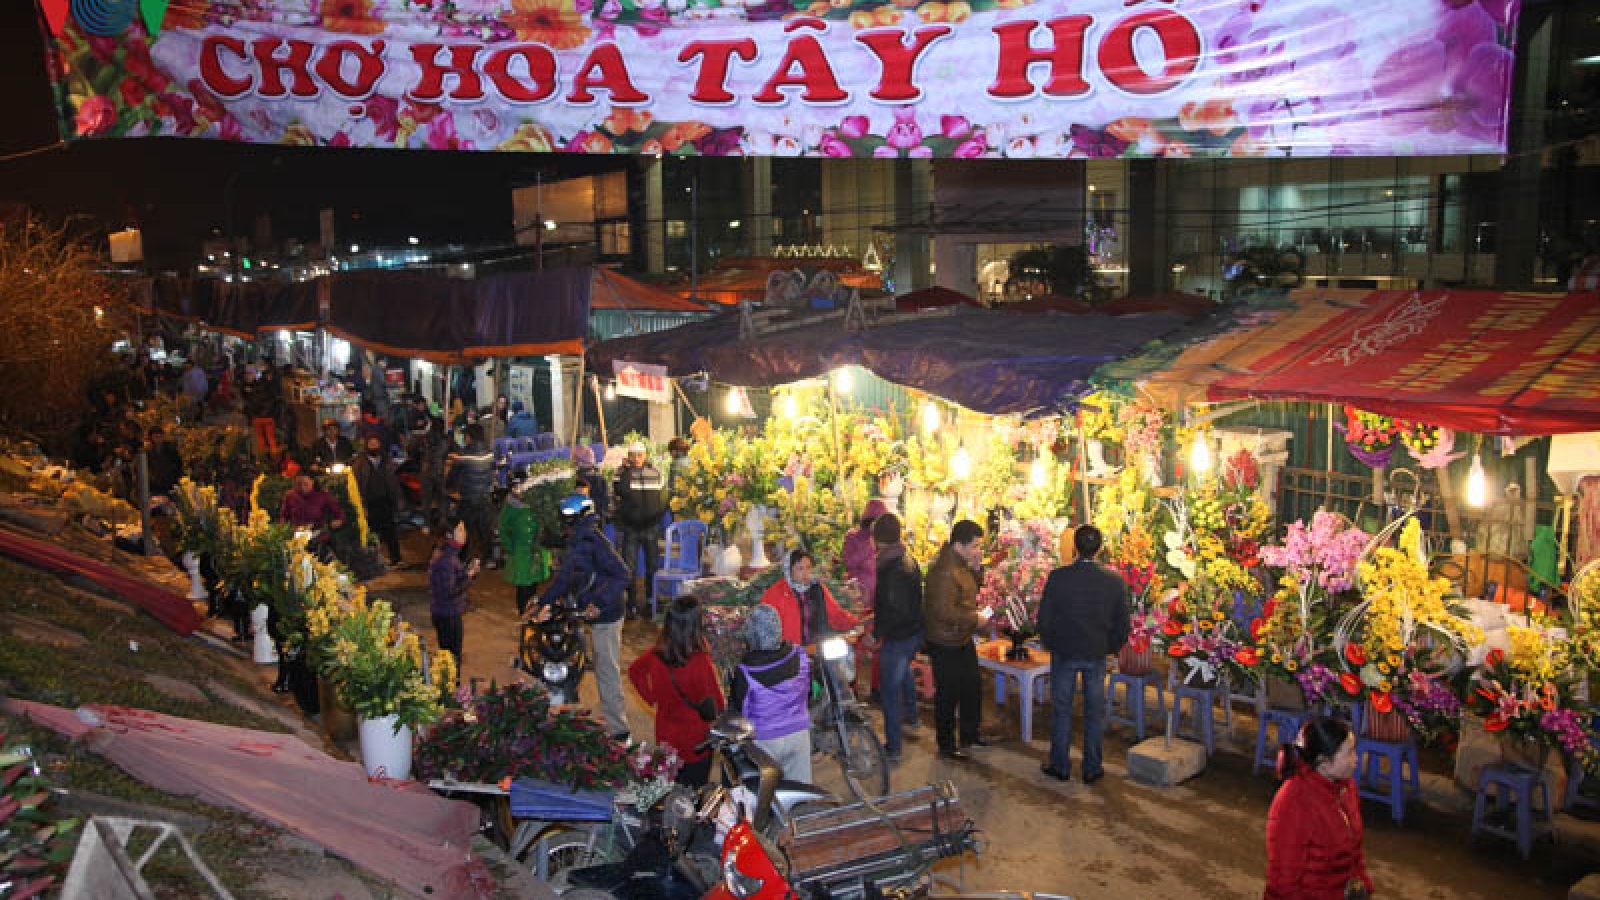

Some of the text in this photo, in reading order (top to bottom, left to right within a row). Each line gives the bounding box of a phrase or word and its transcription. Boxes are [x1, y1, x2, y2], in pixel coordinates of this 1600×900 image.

[200, 36, 386, 116] CHỢ
[409, 41, 650, 103] HOA
[678, 18, 951, 102] TÂY
